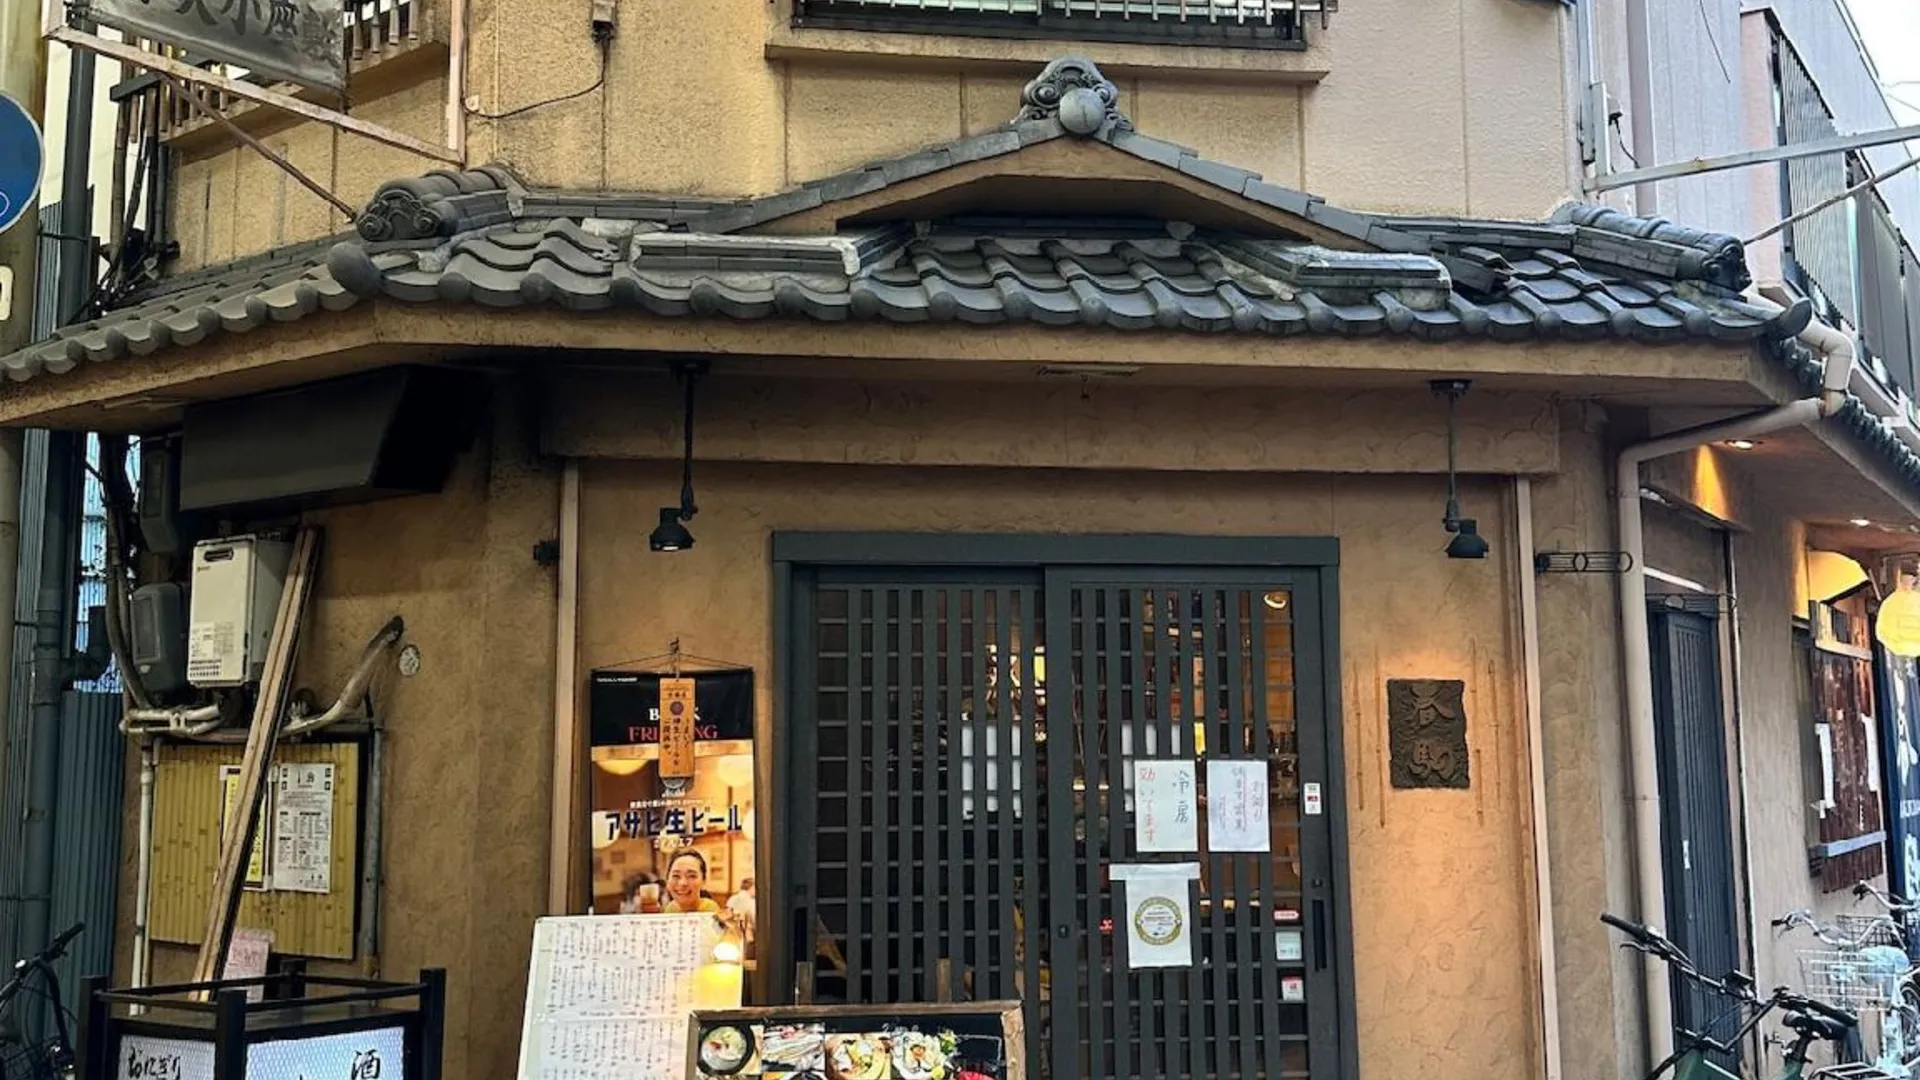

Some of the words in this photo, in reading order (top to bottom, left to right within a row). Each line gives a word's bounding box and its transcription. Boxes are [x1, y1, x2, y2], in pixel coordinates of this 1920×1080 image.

[1172, 768, 1191, 824] 冷房
[605, 804, 743, 840] アサヒ生ビール
